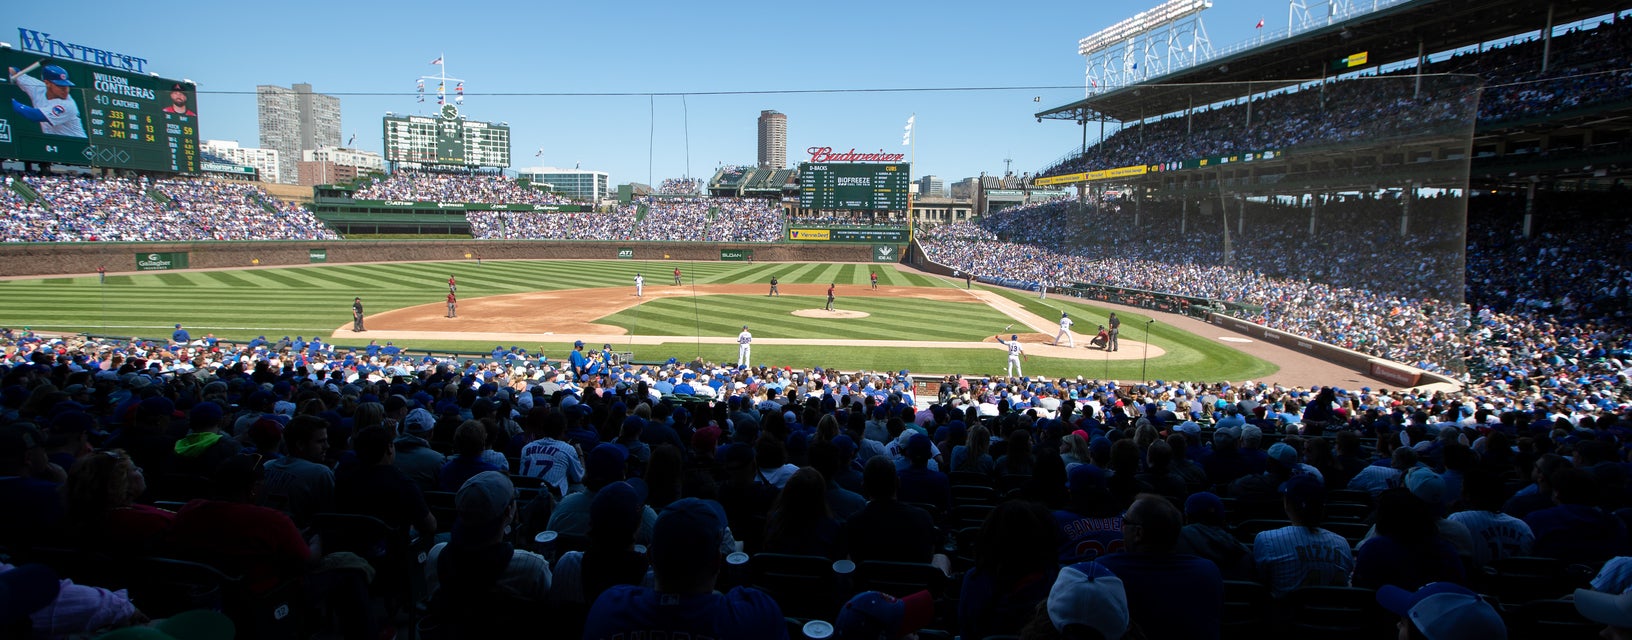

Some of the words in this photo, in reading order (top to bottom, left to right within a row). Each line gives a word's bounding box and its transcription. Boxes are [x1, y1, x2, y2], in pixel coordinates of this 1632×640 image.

[17, 27, 148, 74] WINTRUST
[93, 72, 128, 85] WILLSON
[94, 80, 155, 100] CONTRERAS
[94, 94, 109, 105] 40
[112, 98, 140, 109] CATCHER
[108, 110, 125, 120] .333
[145, 115, 152, 123] 6
[109, 120, 126, 130] .471
[145, 124, 155, 133] 13
[110, 129, 126, 139] .741
[183, 126, 194, 135] 59
[145, 134, 155, 142] 54
[46, 144, 58, 153] 0-1
[807, 146, 905, 163] Budweiser
[837, 176, 871, 184] BIOFREEZE
[525, 445, 560, 457] BRYANT
[522, 459, 555, 477] 17
[1063, 516, 1126, 538] SANDBE
